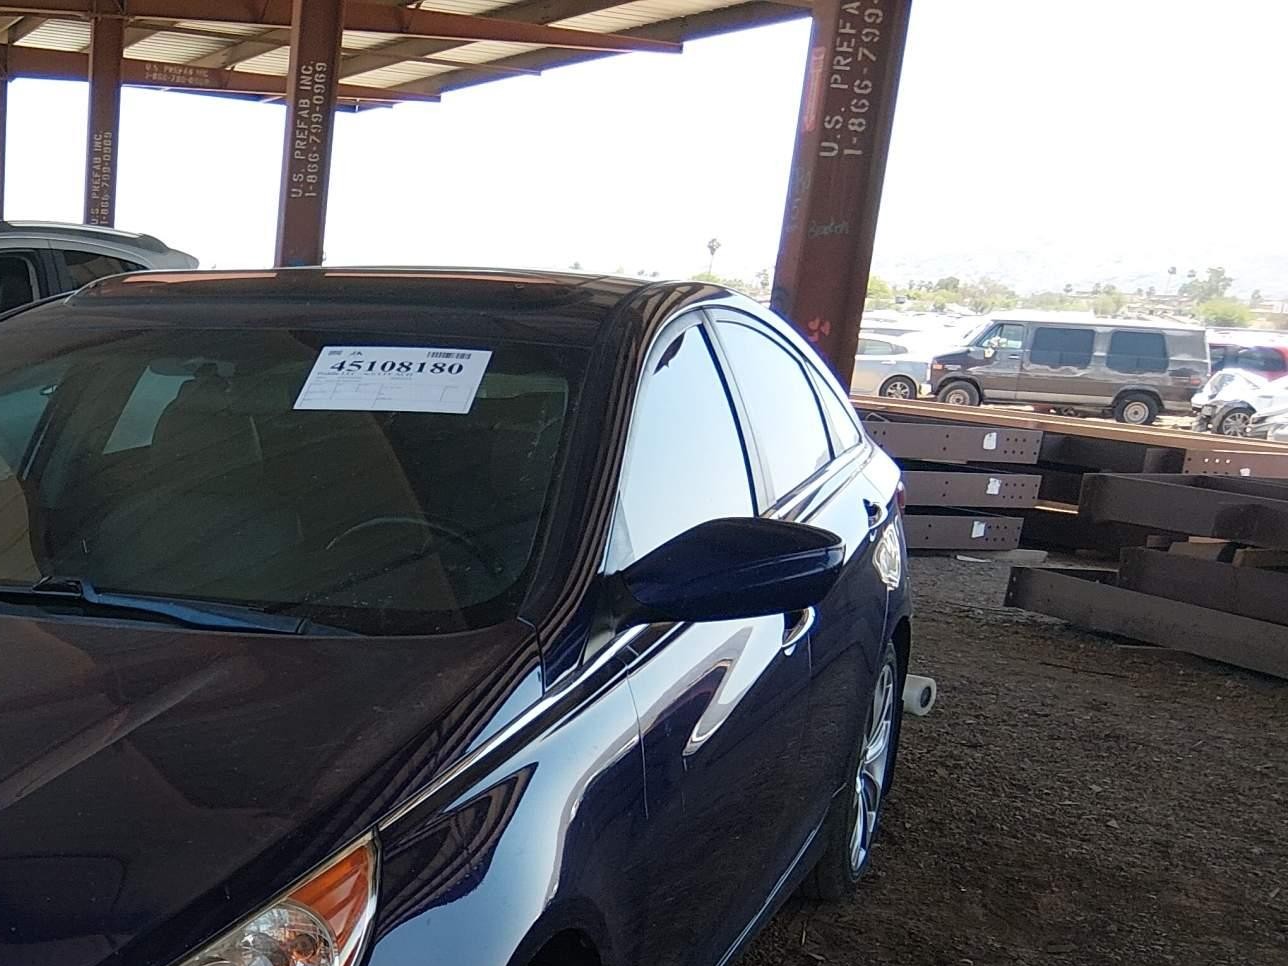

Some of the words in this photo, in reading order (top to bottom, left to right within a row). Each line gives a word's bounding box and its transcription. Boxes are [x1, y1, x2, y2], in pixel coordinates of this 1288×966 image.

[299, 60, 314, 91] INC.
[294, 98, 311, 159] PREFAB
[819, 107, 845, 157] U.S.
[290, 168, 306, 198] U.S.
[329, 359, 465, 376] 45108180
